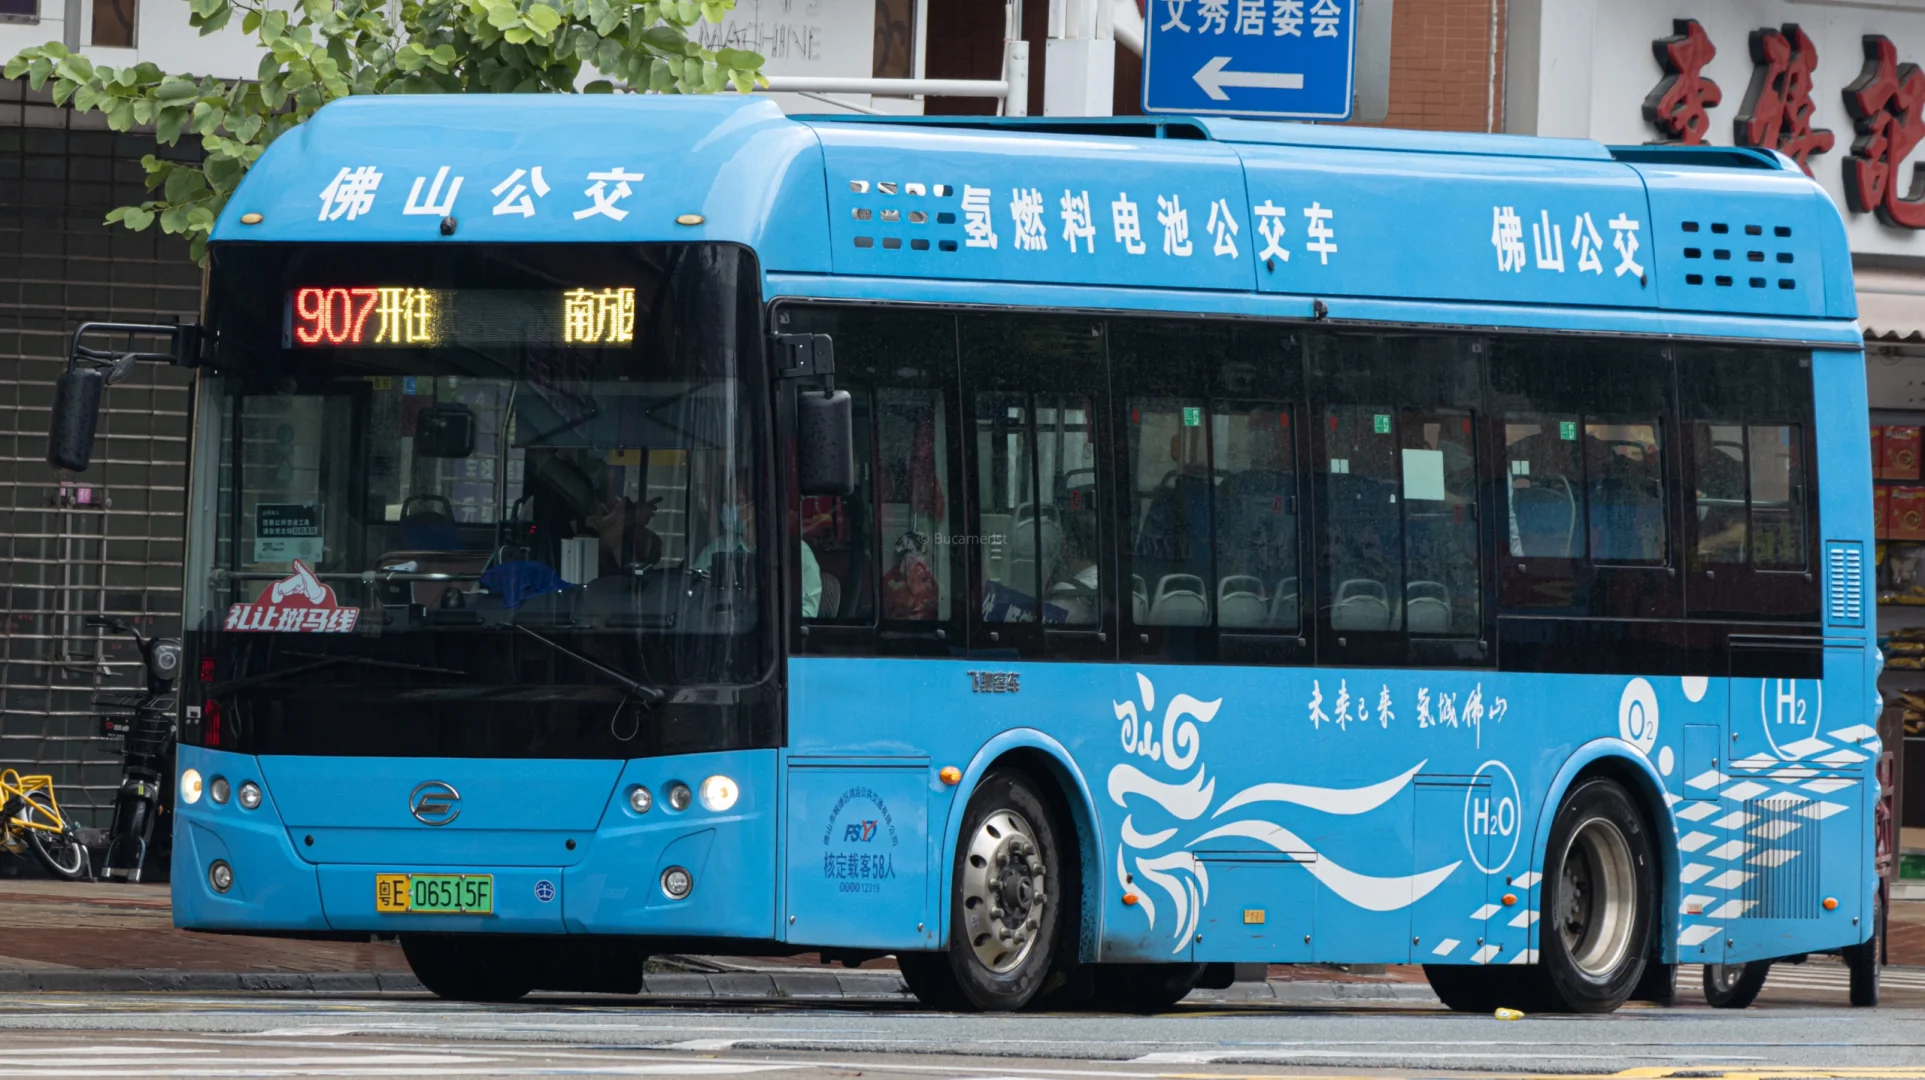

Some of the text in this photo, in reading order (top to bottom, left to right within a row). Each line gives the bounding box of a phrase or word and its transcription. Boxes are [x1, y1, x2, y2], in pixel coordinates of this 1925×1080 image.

[1160, 0, 1342, 38] 文秀居委会
[318, 165, 645, 222] 佛山公交
[960, 184, 1645, 278] 氢燃料电池公交车 佛山公交
[226, 605, 357, 632] 礼让斑马线
[1776, 679, 1807, 724] H2
[1473, 797, 1515, 836] H2O
[824, 852, 896, 880] 核定载客58人
